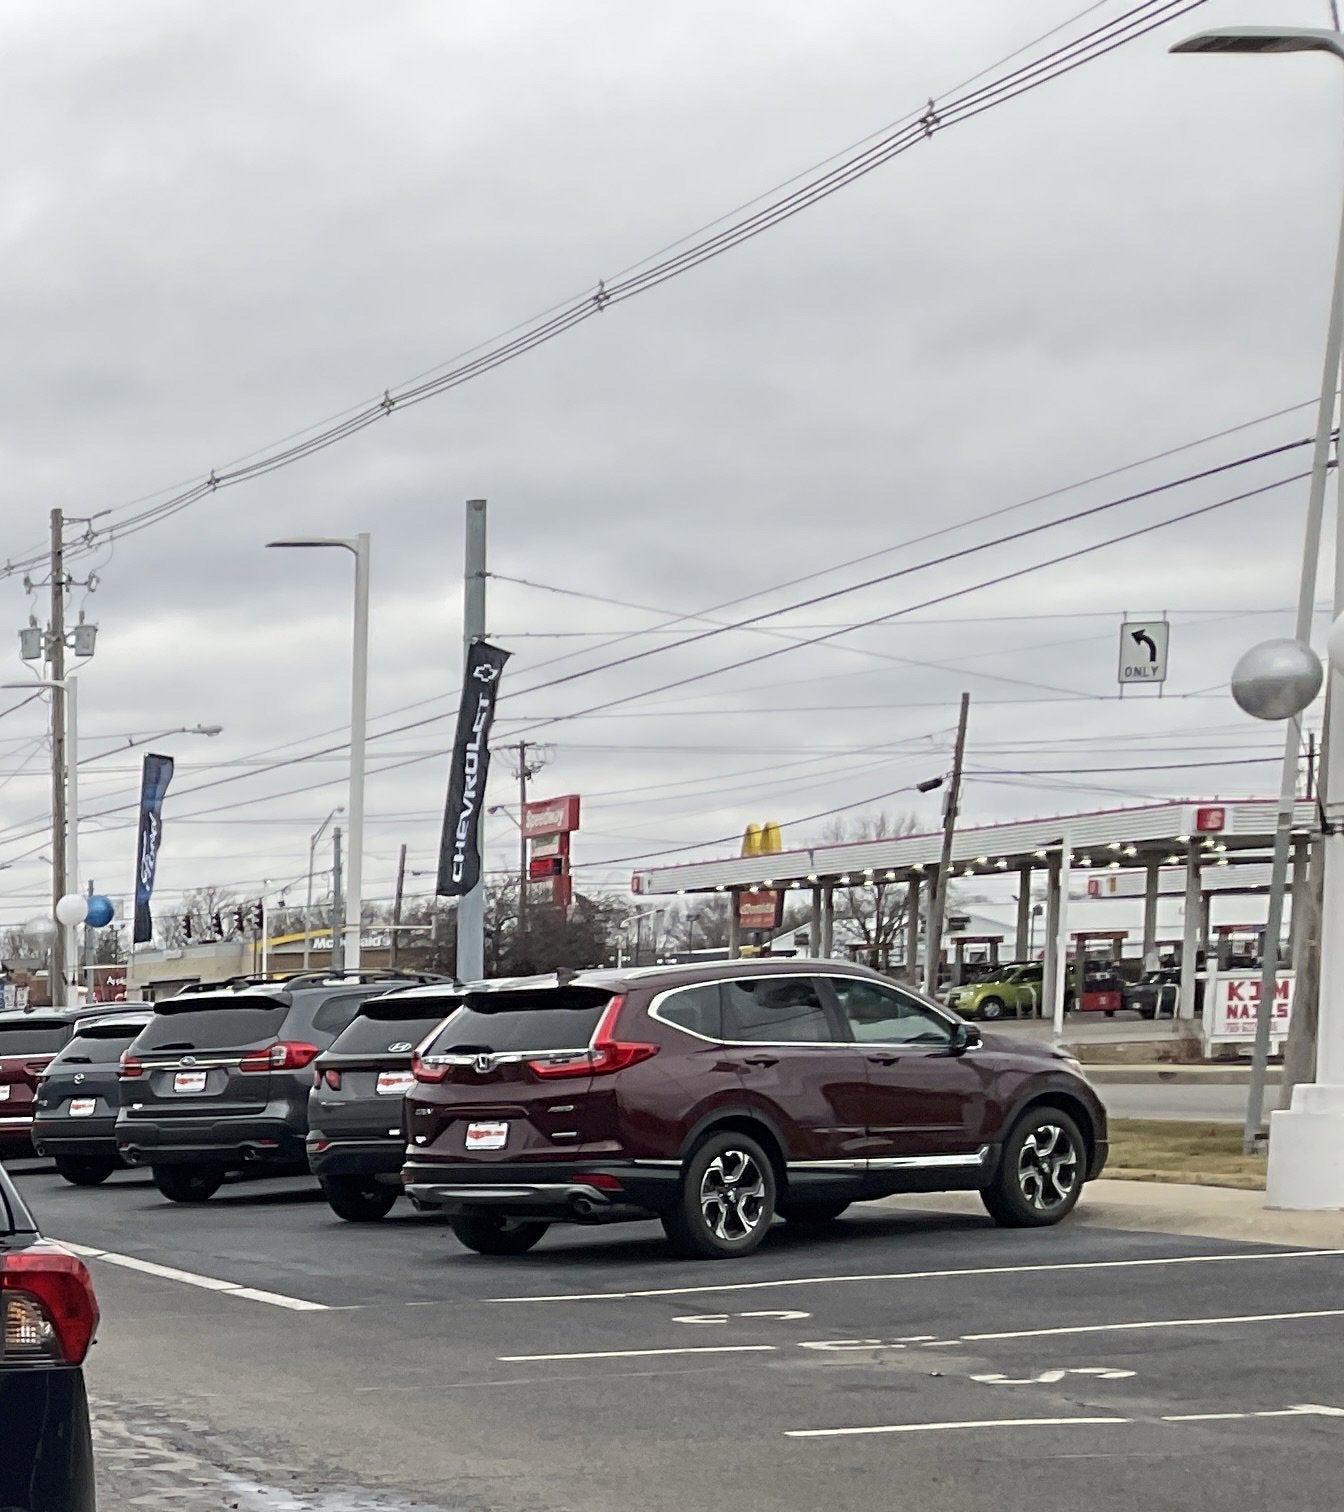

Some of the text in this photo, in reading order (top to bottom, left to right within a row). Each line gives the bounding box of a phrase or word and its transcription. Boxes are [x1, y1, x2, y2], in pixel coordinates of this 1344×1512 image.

[1124, 665, 1159, 678] ONLY
[451, 692, 490, 883] CHEVROLET
[1227, 979, 1290, 1002] KIM
[1226, 1003, 1289, 1019] NAIS
